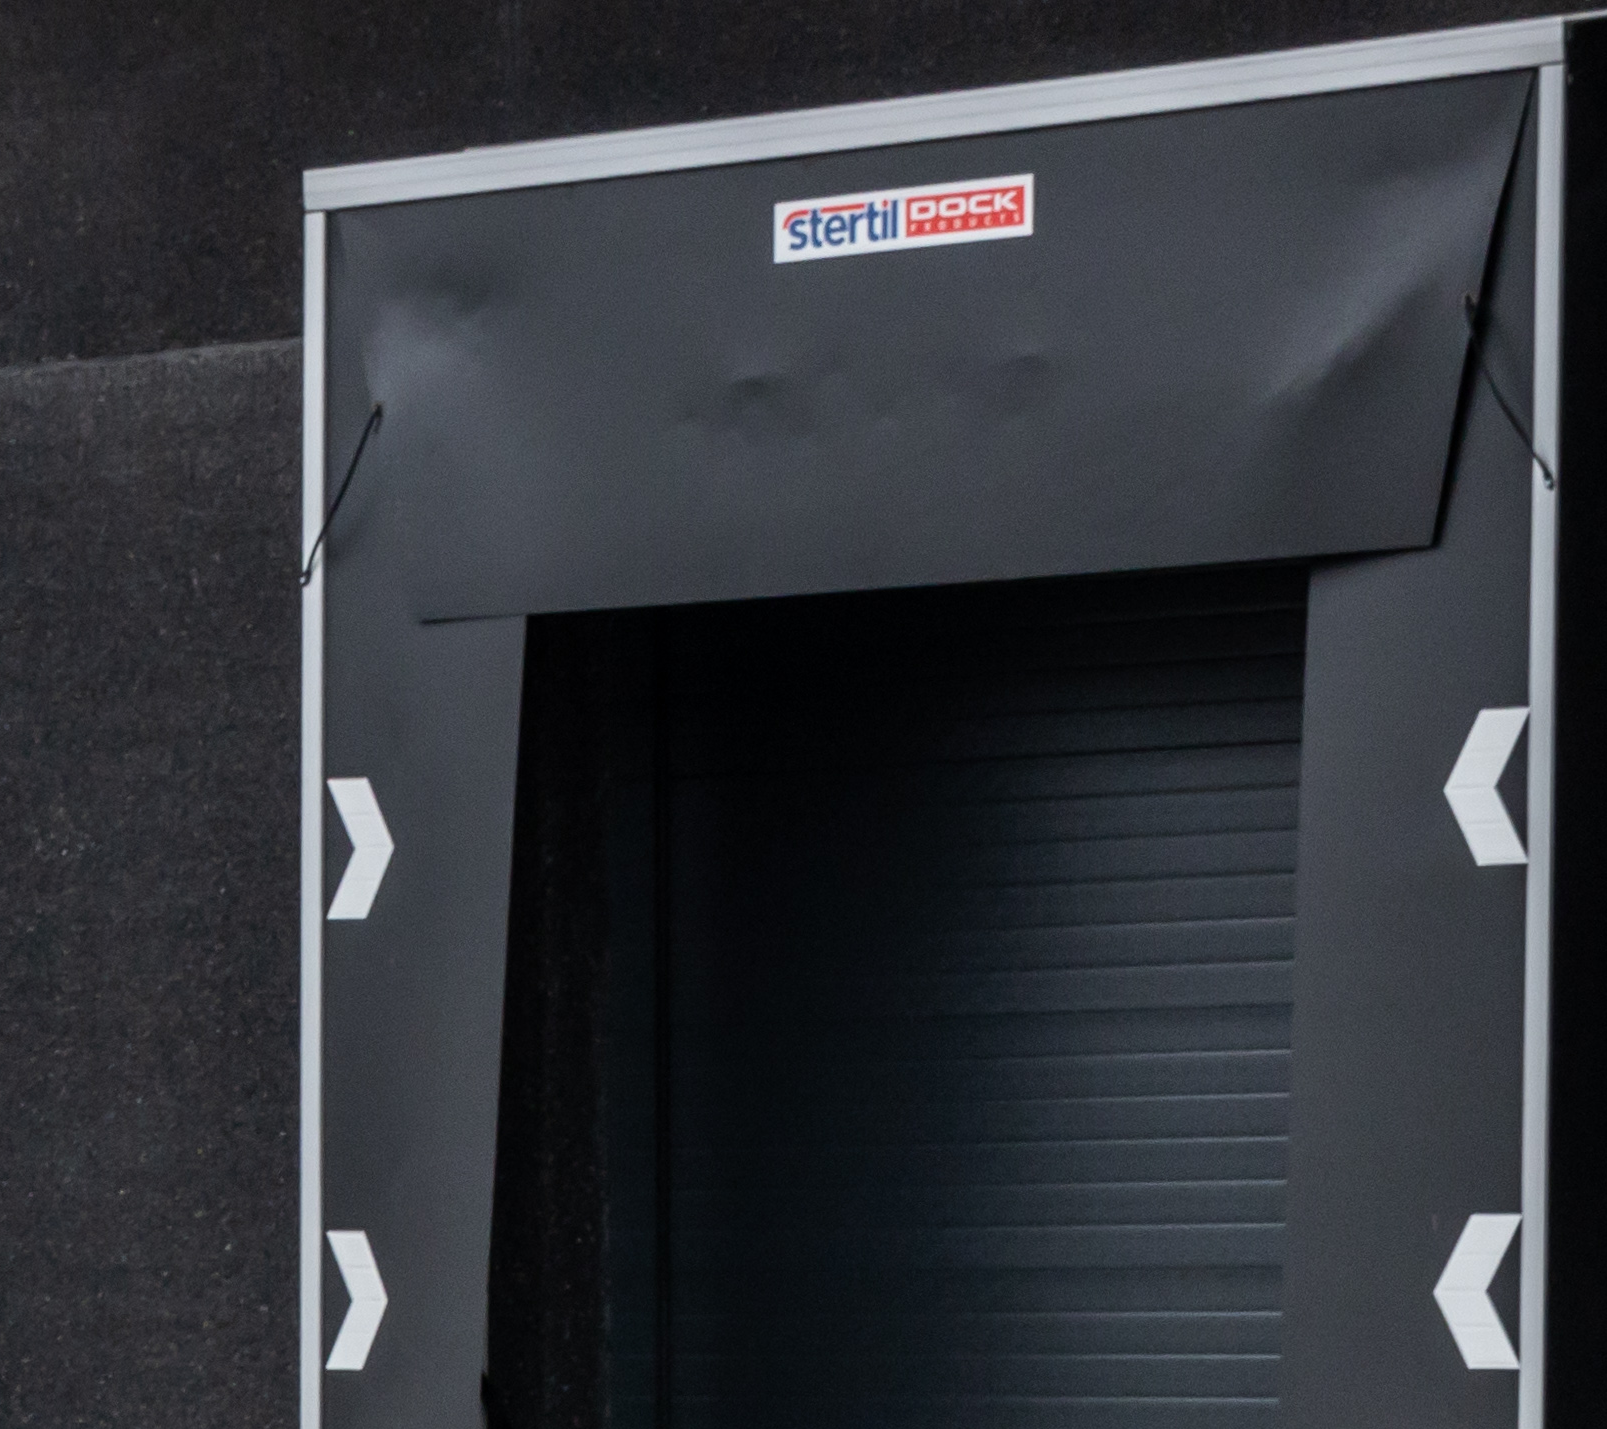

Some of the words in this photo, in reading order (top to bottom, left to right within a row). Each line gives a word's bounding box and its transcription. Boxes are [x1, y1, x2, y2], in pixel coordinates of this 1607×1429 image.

[789, 199, 898, 250] stertil
[910, 190, 1017, 221] DOCK
[910, 212, 1021, 233] PRODUCTS
